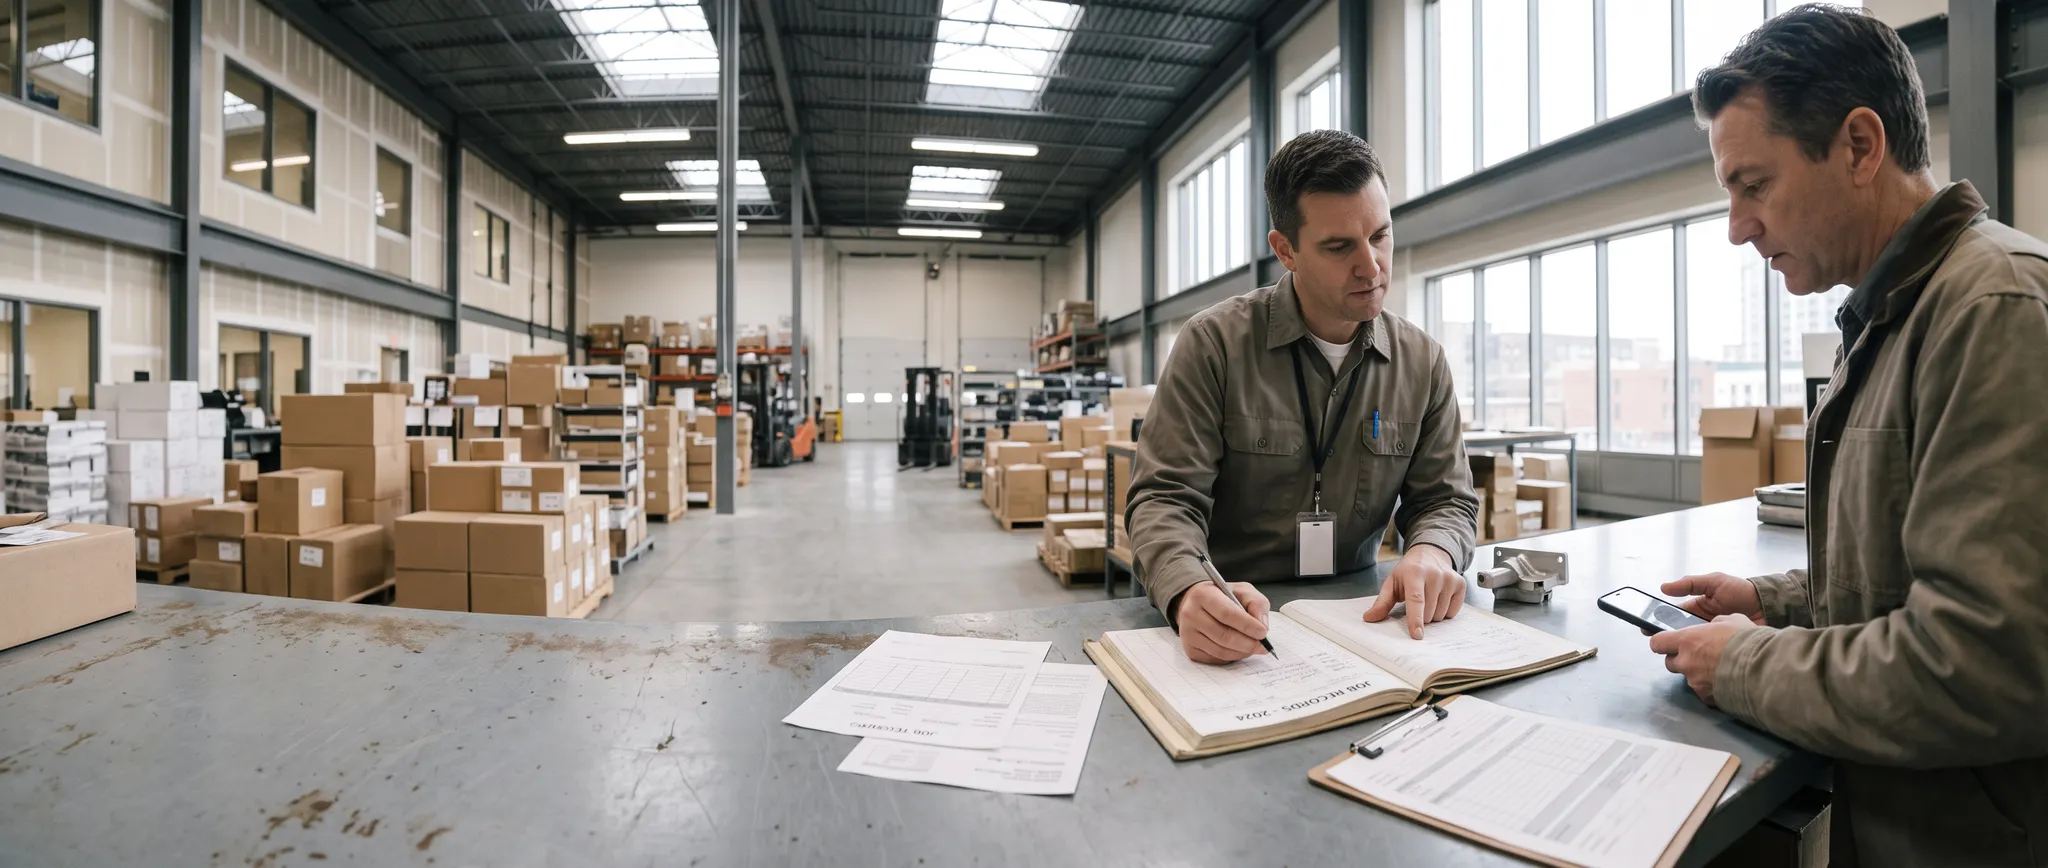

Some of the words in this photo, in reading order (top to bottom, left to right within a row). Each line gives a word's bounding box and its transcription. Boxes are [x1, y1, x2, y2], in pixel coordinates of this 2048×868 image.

[1347, 680, 1372, 692] JOB
[1282, 688, 1345, 712] RECORDS
[1235, 710, 1271, 721] 2024
